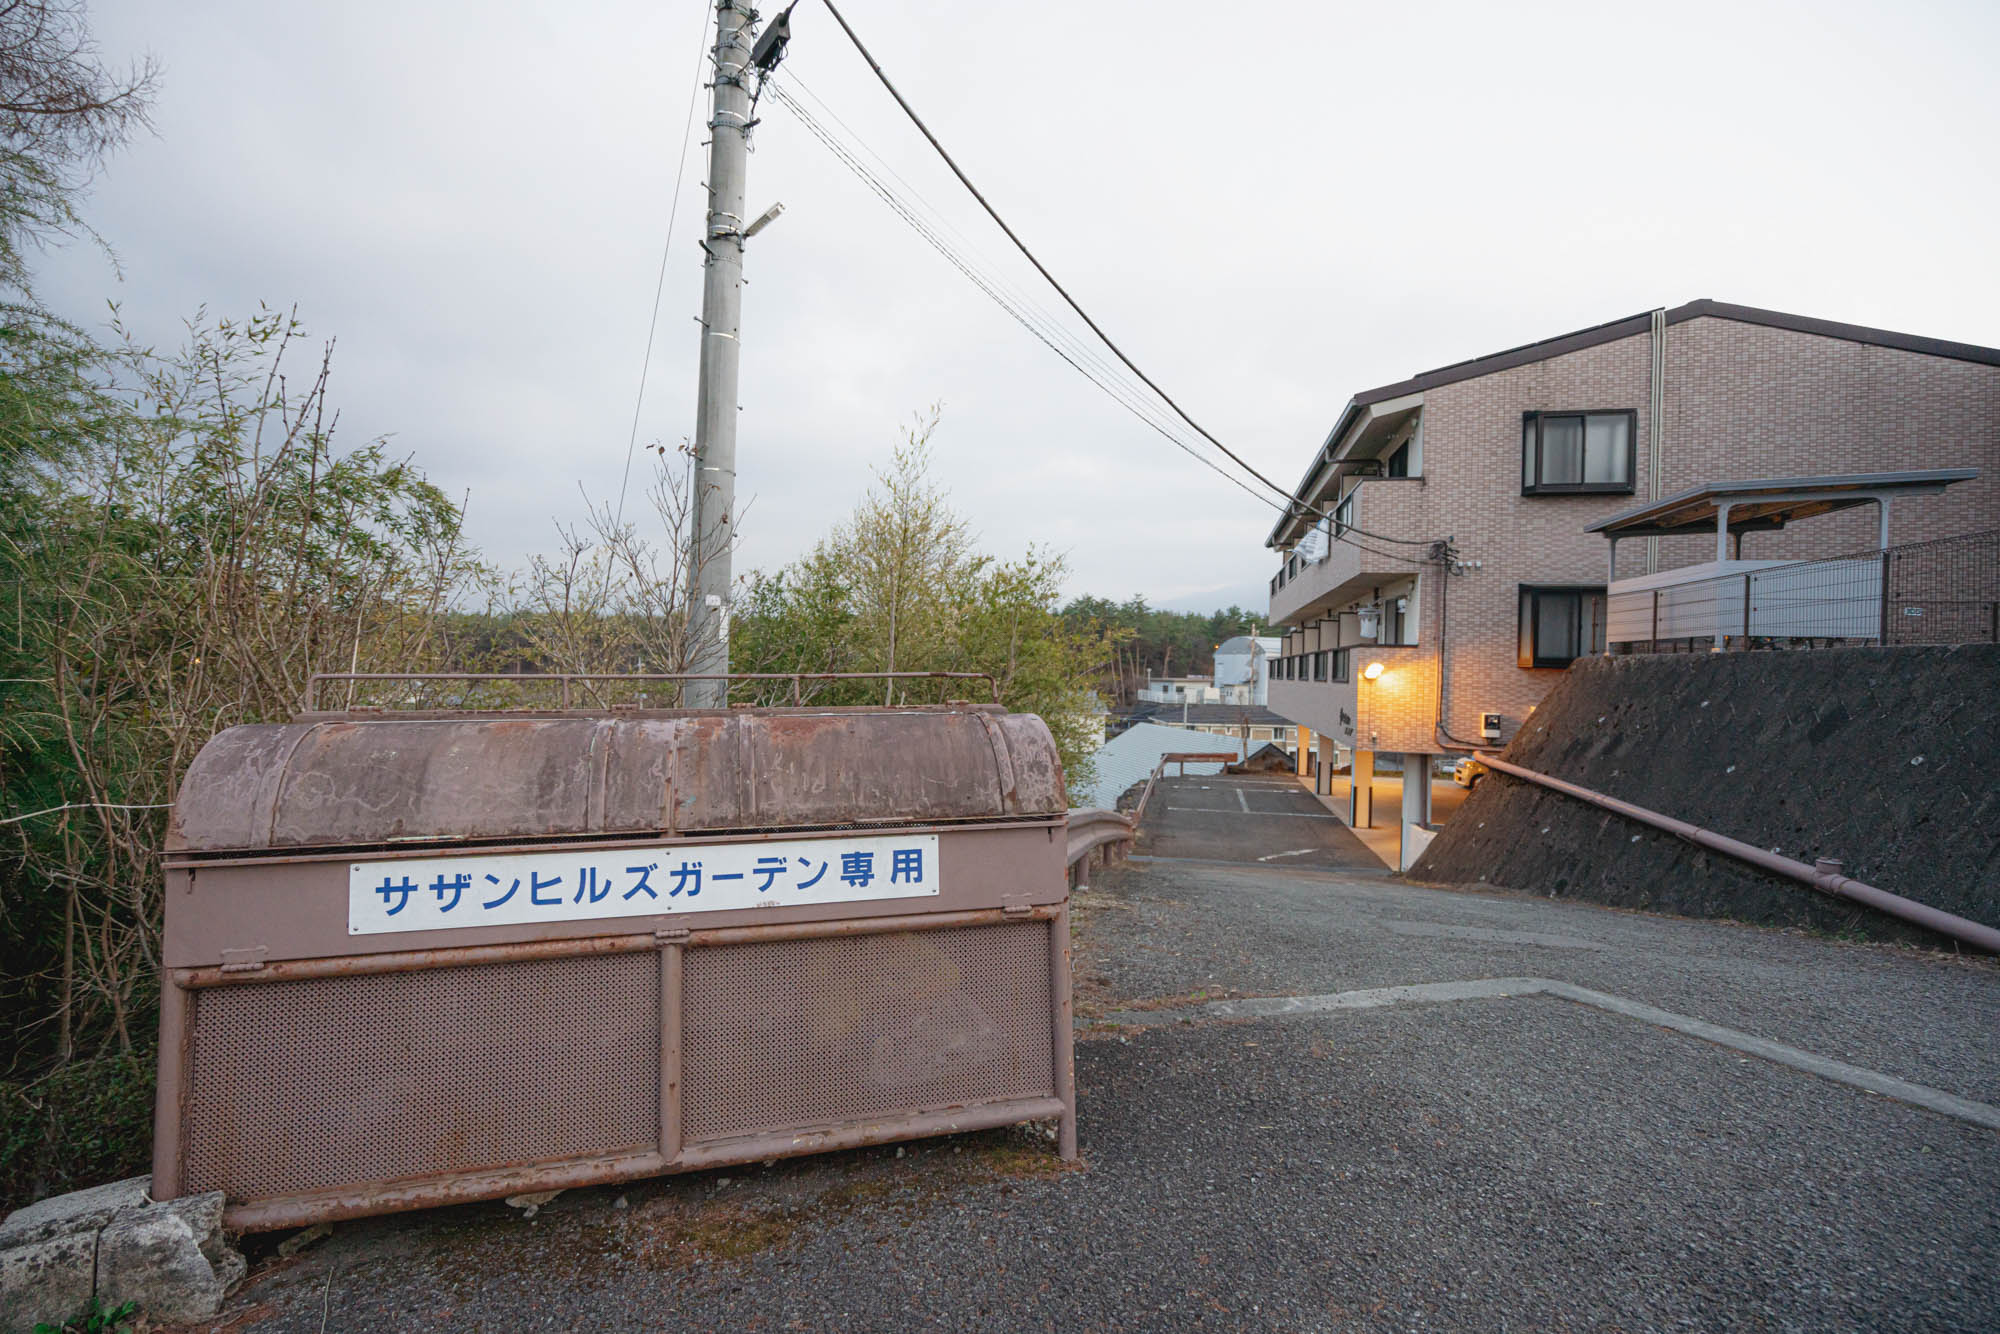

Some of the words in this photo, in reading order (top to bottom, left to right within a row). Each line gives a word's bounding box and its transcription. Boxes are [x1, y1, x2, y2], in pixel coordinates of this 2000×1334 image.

[375, 849, 923, 917] サザンヒルズガーデン専用
